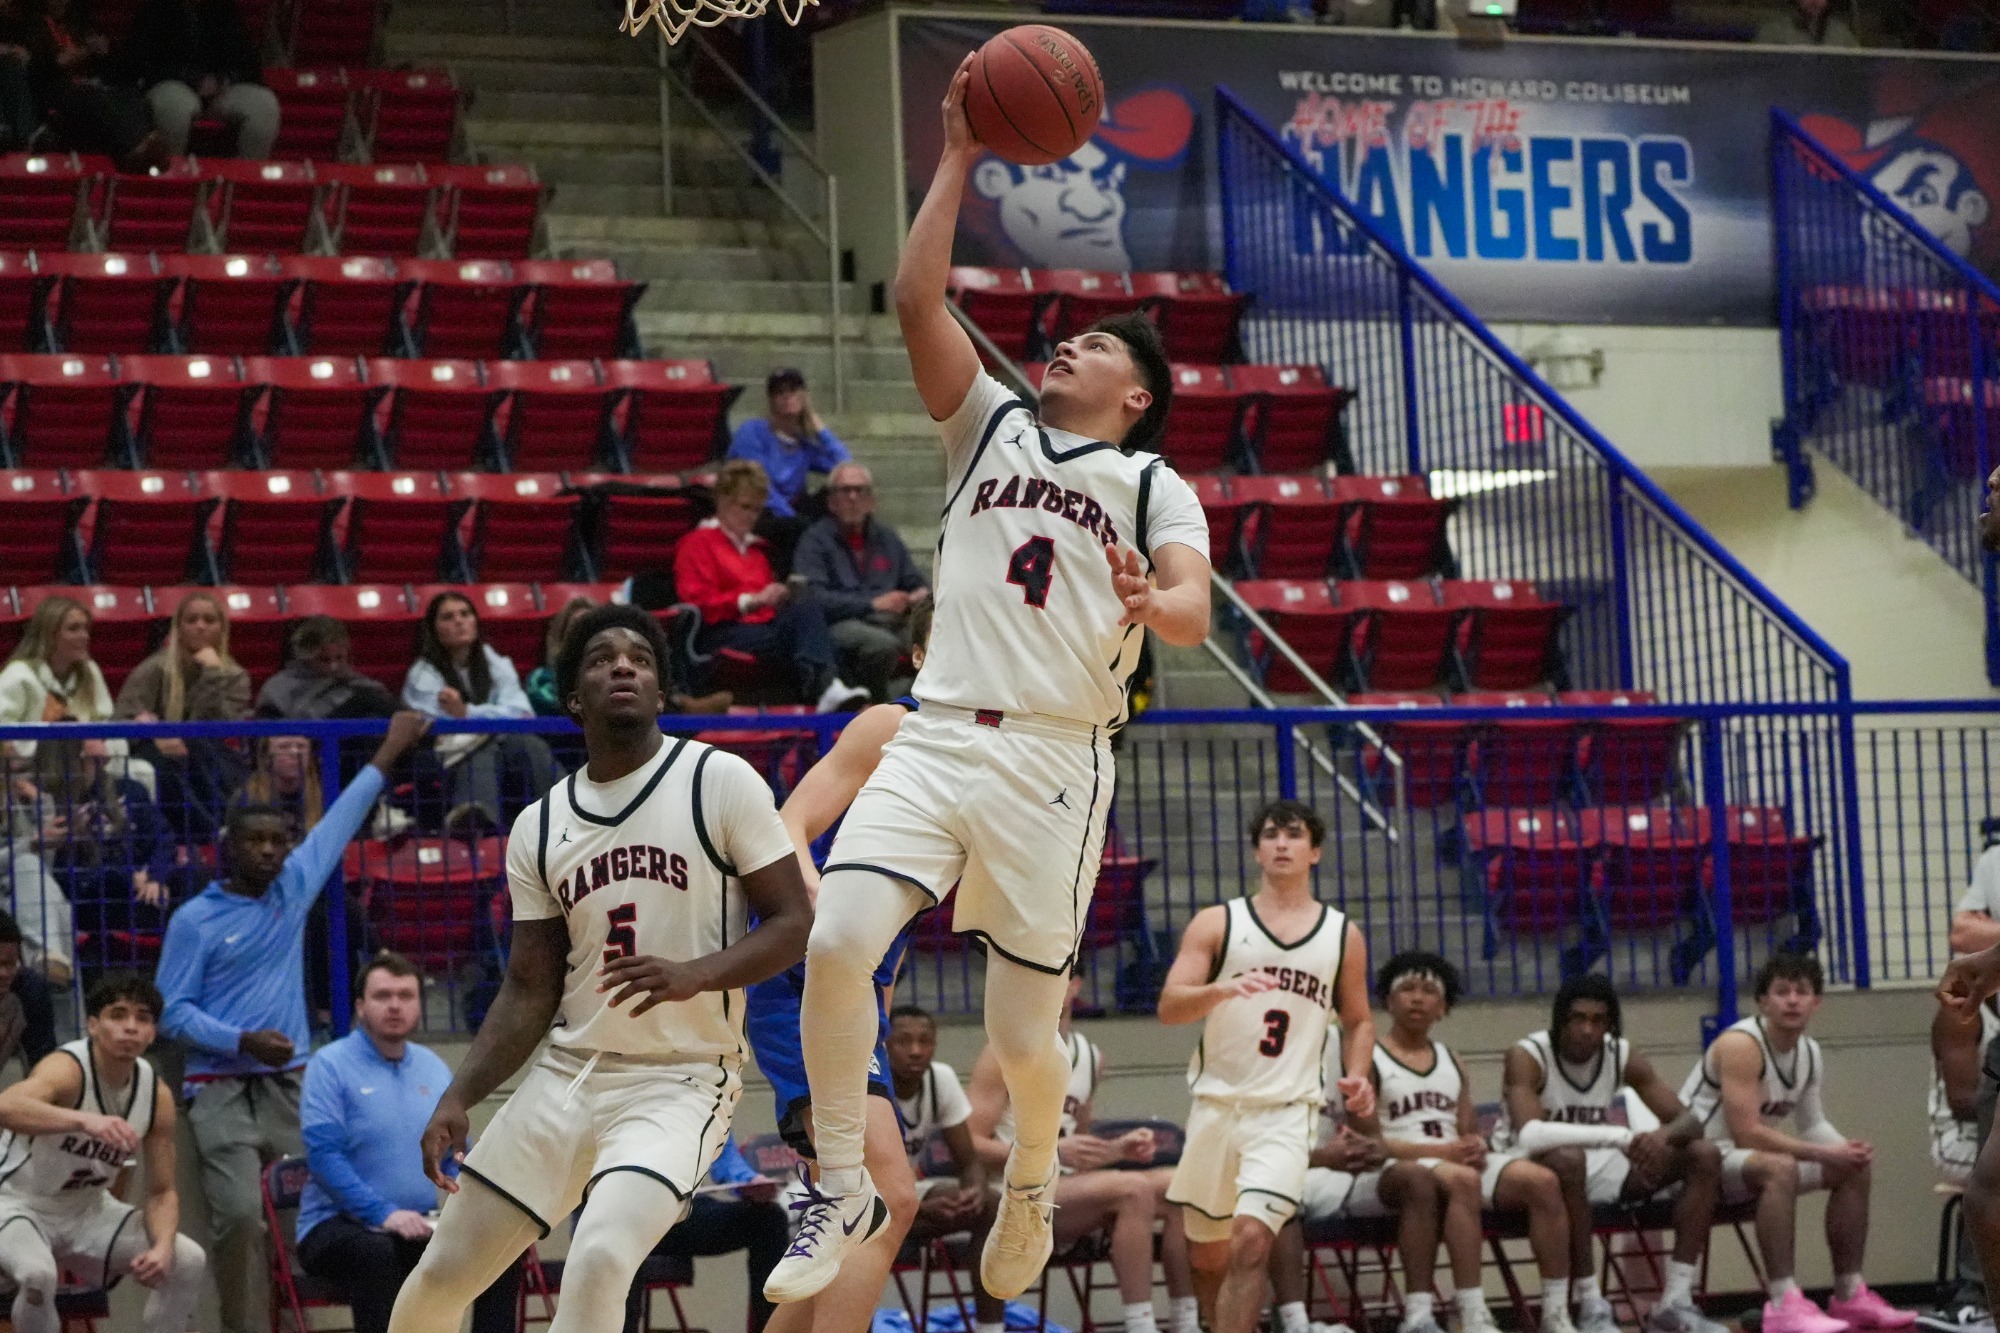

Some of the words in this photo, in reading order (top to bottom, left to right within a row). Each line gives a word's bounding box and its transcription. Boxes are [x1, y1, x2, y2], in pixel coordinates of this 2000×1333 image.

[1037, 31, 1096, 115] SPALDING
[1278, 71, 1402, 95] WELCOME
[1410, 75, 1443, 96] TO
[1451, 77, 1558, 100] HOWARD
[1564, 81, 1691, 104] COLISEUM
[970, 475, 1119, 547] RANGERS
[1006, 535, 1055, 610] 4
[557, 844, 689, 917] RANGERS
[603, 902, 637, 965] 5
[1259, 1009, 1291, 1058] 3
